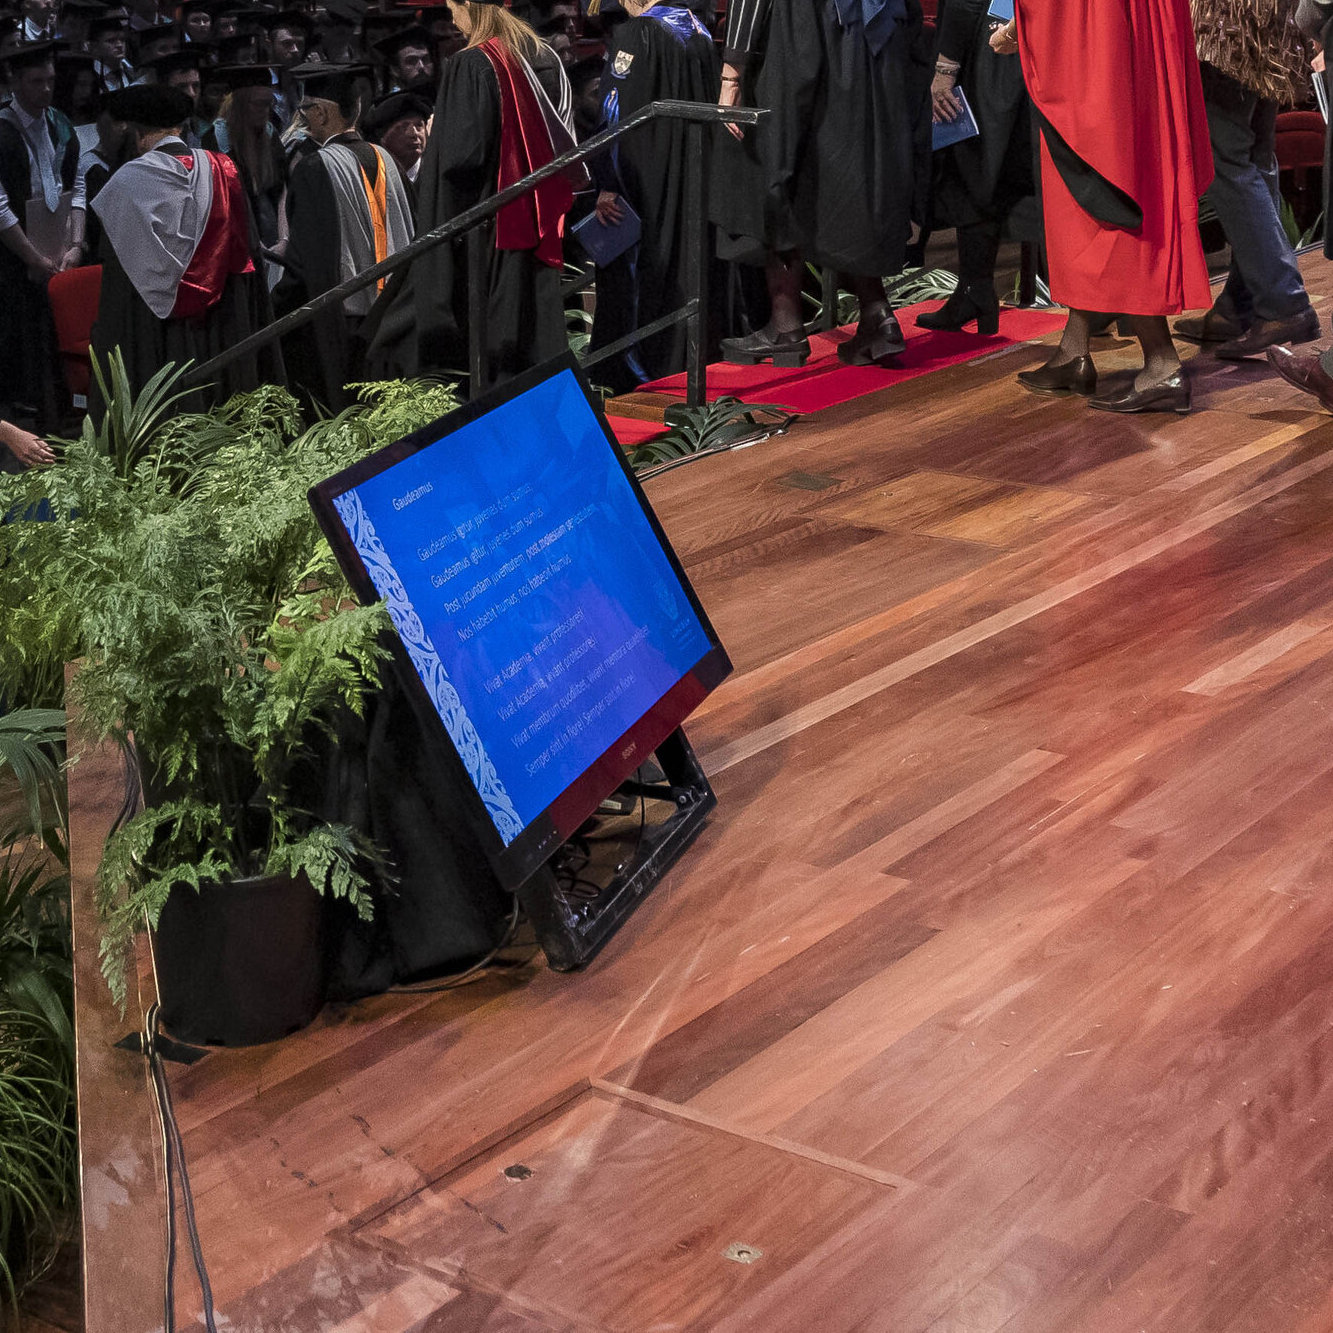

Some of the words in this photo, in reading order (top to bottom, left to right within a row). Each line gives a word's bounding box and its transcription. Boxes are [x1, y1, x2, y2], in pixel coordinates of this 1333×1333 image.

[391, 481, 433, 511] Gaudeamus
[416, 530, 457, 562] Gaudeamus
[430, 556, 470, 589] Gaudeamus
[444, 597, 461, 616] Post
[458, 577, 494, 608] jucundam
[525, 541, 541, 561] post
[457, 625, 473, 642] Nos
[471, 606, 497, 632] habebit
[484, 673, 503, 695] Vivat
[498, 700, 517, 723] Vivat
[511, 727, 530, 750] Vivat
[528, 702, 561, 736] membrum
